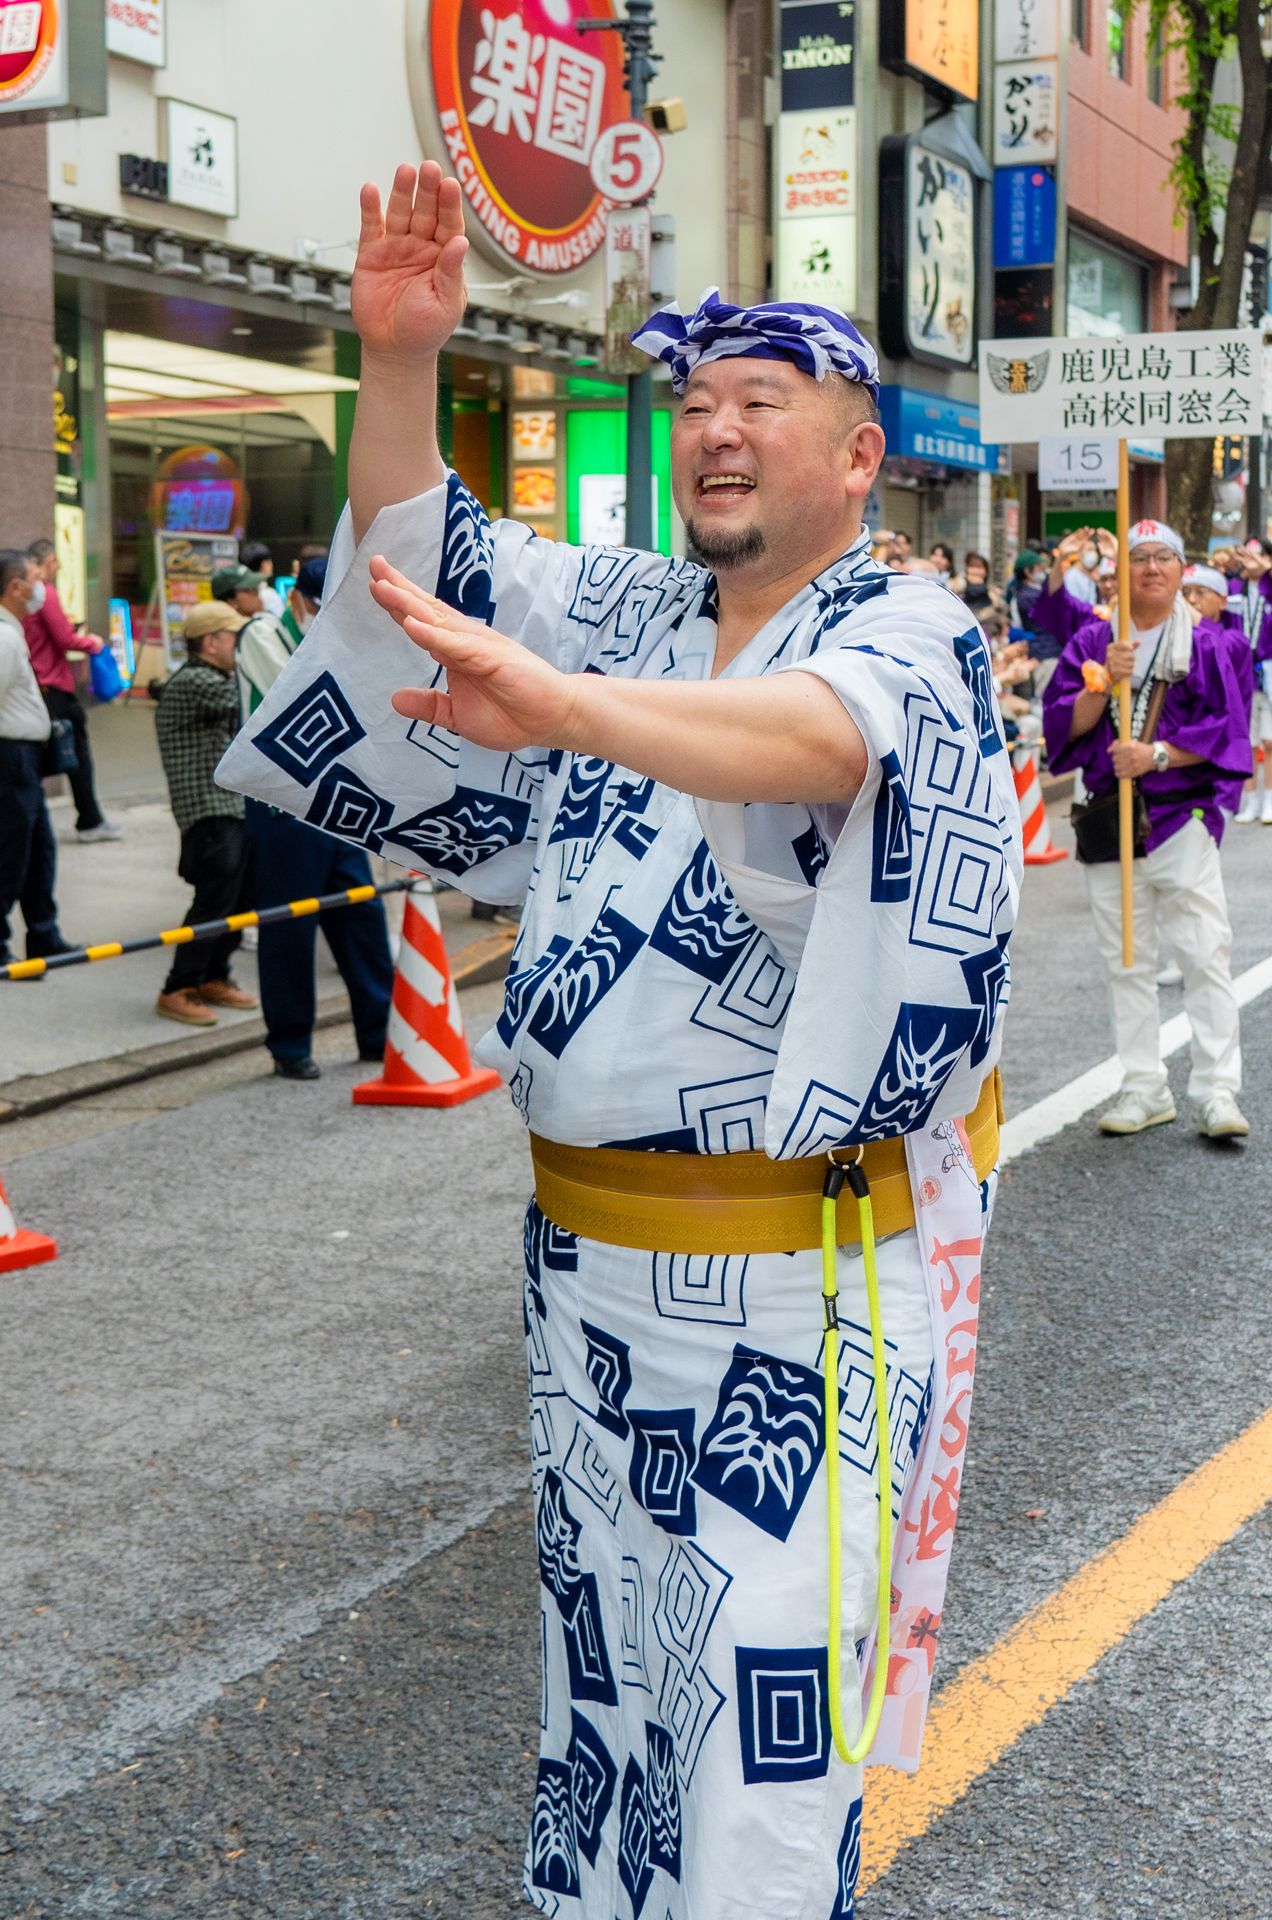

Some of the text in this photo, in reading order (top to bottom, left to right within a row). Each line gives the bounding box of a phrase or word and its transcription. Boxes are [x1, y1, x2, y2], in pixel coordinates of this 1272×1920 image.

[783, 44, 852, 70] IMON
[467, 8, 607, 166] 楽園
[1004, 76, 1033, 148] かいり
[440, 109, 521, 254] EXCITING
[609, 134, 642, 188] 5
[917, 154, 946, 337] かいり
[1060, 342, 1252, 384] 鹿児島工業
[1063, 388, 1252, 428] 高校同窓会
[1060, 443, 1103, 471] 15
